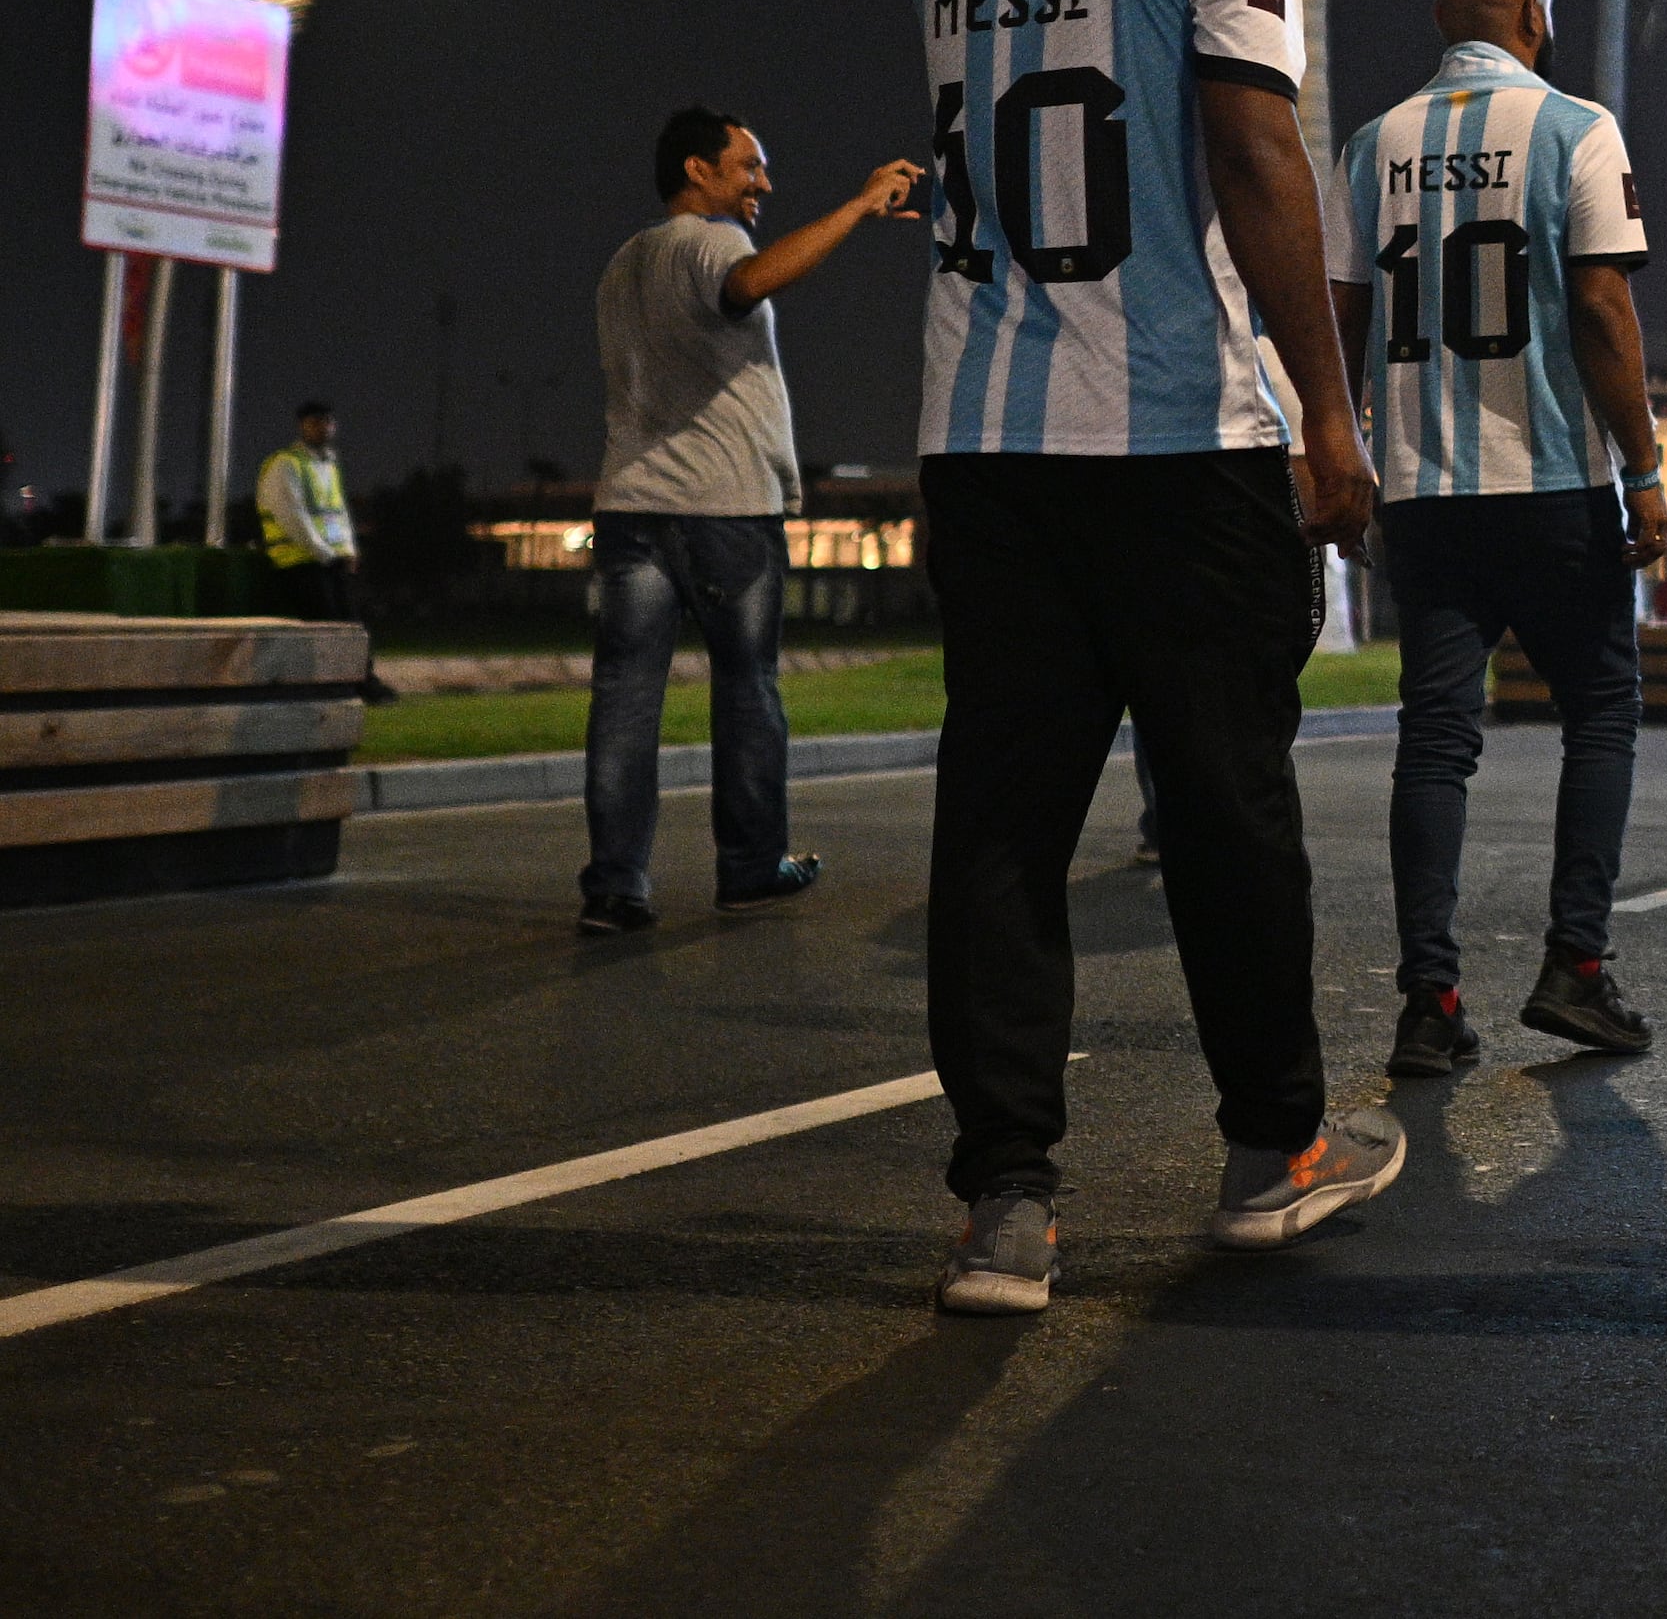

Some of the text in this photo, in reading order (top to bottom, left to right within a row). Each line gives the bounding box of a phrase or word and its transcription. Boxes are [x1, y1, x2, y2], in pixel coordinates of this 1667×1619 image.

[933, 66, 1133, 284] 10
[1389, 150, 1512, 194] MESSI
[1375, 219, 1531, 363] 10
